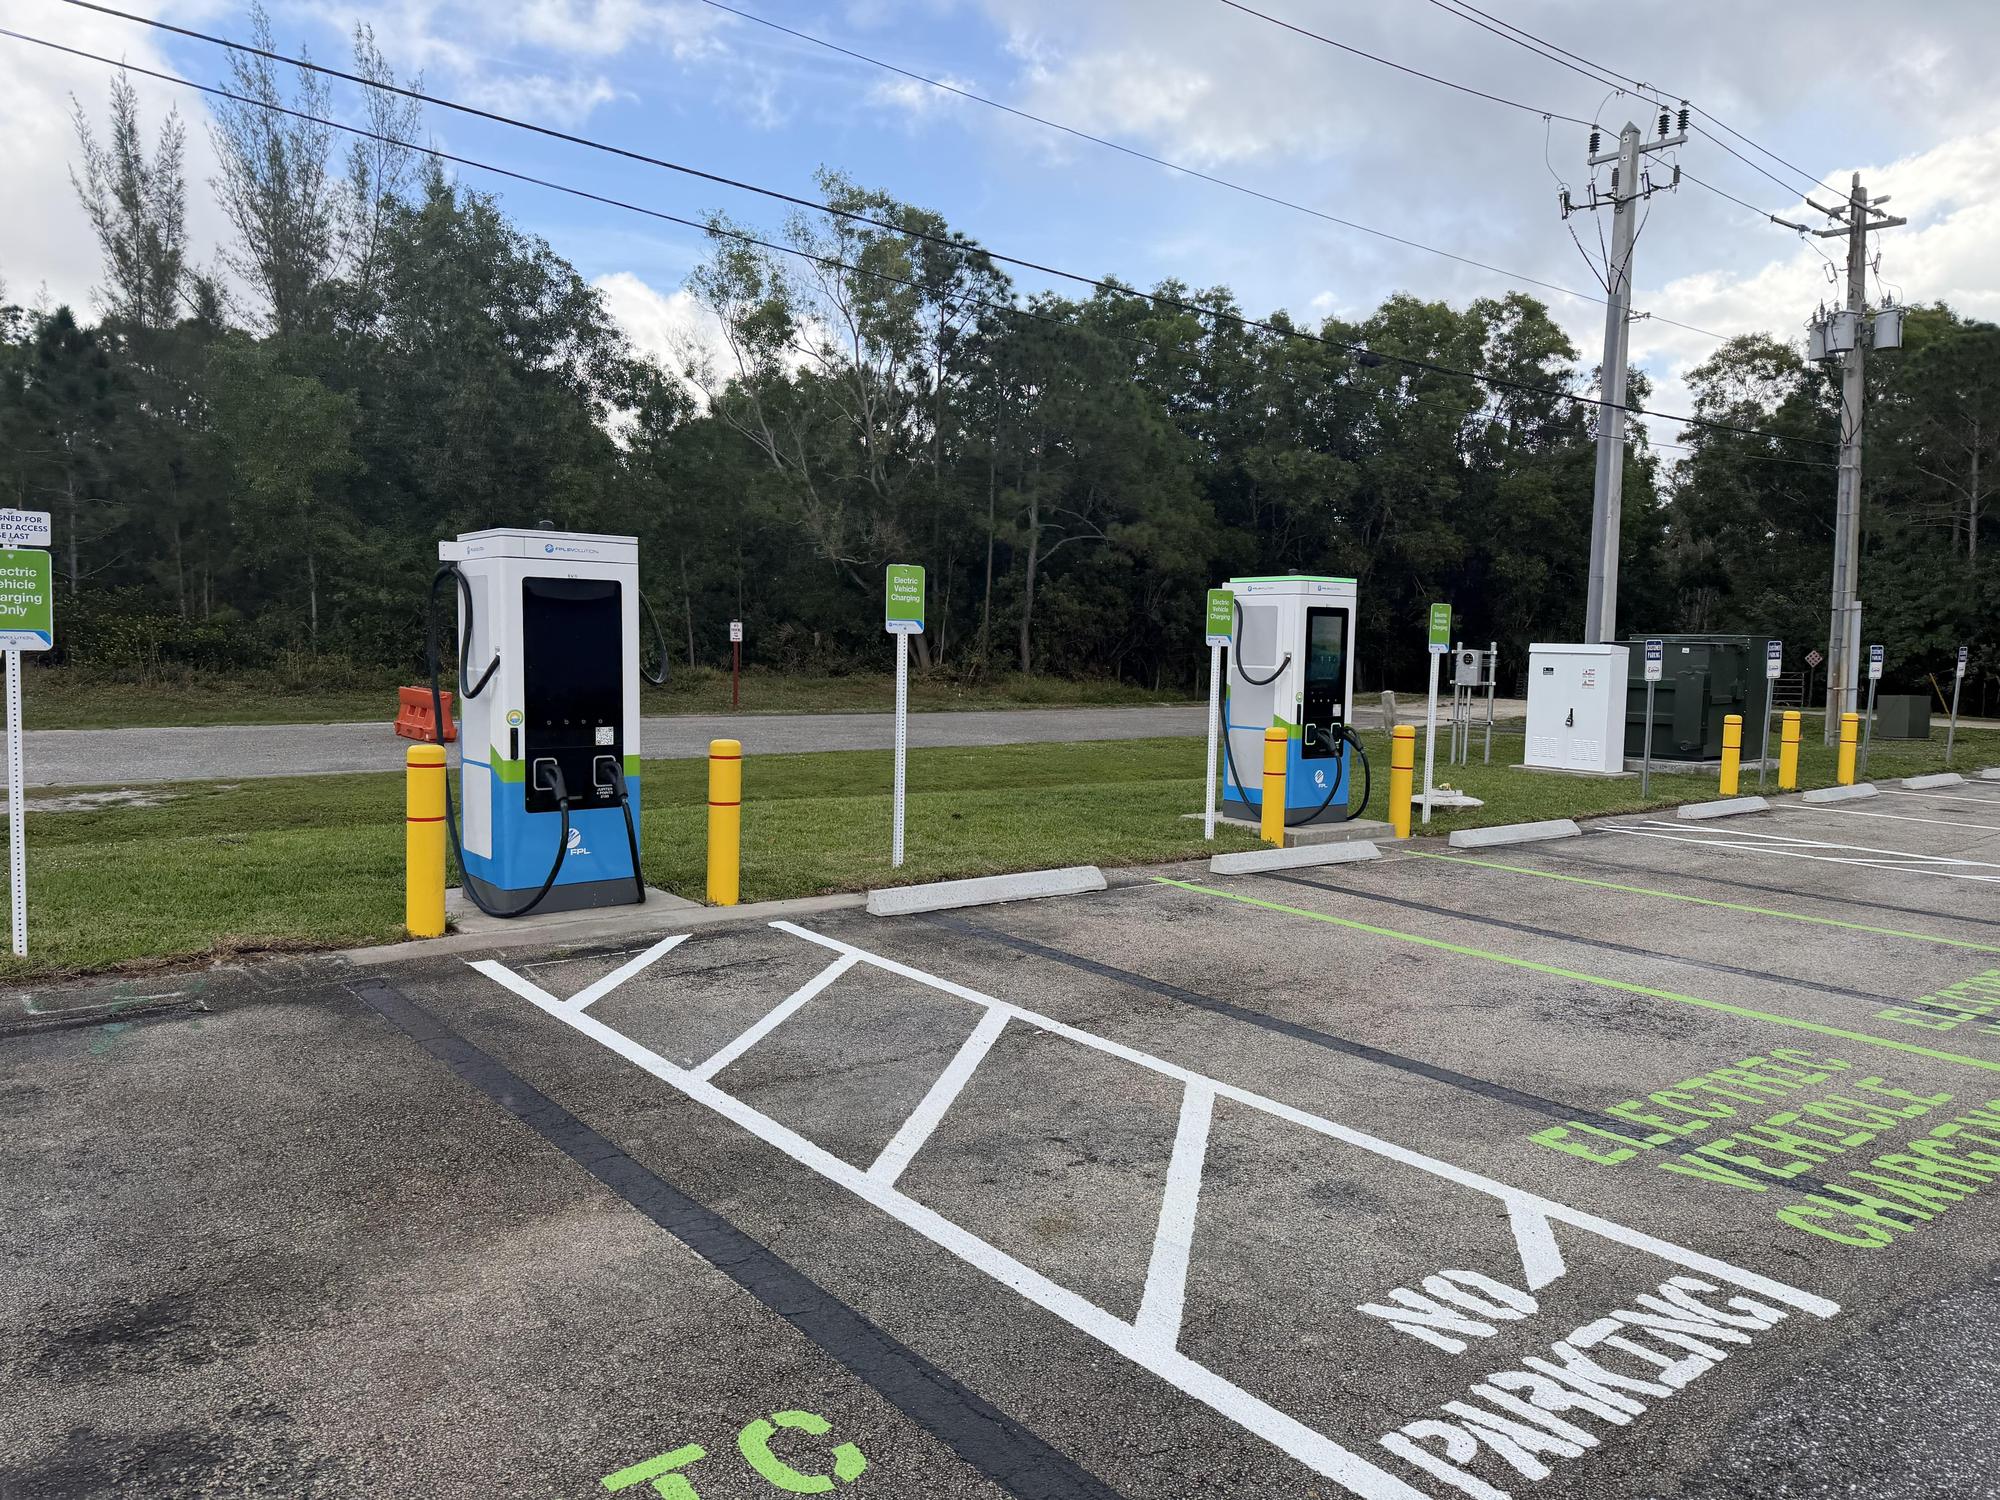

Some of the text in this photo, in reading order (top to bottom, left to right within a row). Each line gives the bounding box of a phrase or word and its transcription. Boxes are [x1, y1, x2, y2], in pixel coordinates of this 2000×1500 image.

[15, 524, 48, 532] ACCESS
[10, 532, 30, 540] LAST
[893, 576, 919, 585] Electric
[894, 584, 918, 593] Vehicle
[891, 593, 920, 603] Charging
[0, 604, 27, 616] Only
[1210, 613, 1231, 621] Charging
[570, 848, 592, 856] FPL
[1529, 1048, 1852, 1166] ELECTRIC
[1658, 1076, 1953, 1192] VEHICLE
[1356, 1270, 1539, 1355] NO
[1378, 1276, 1789, 1500] PARKING
